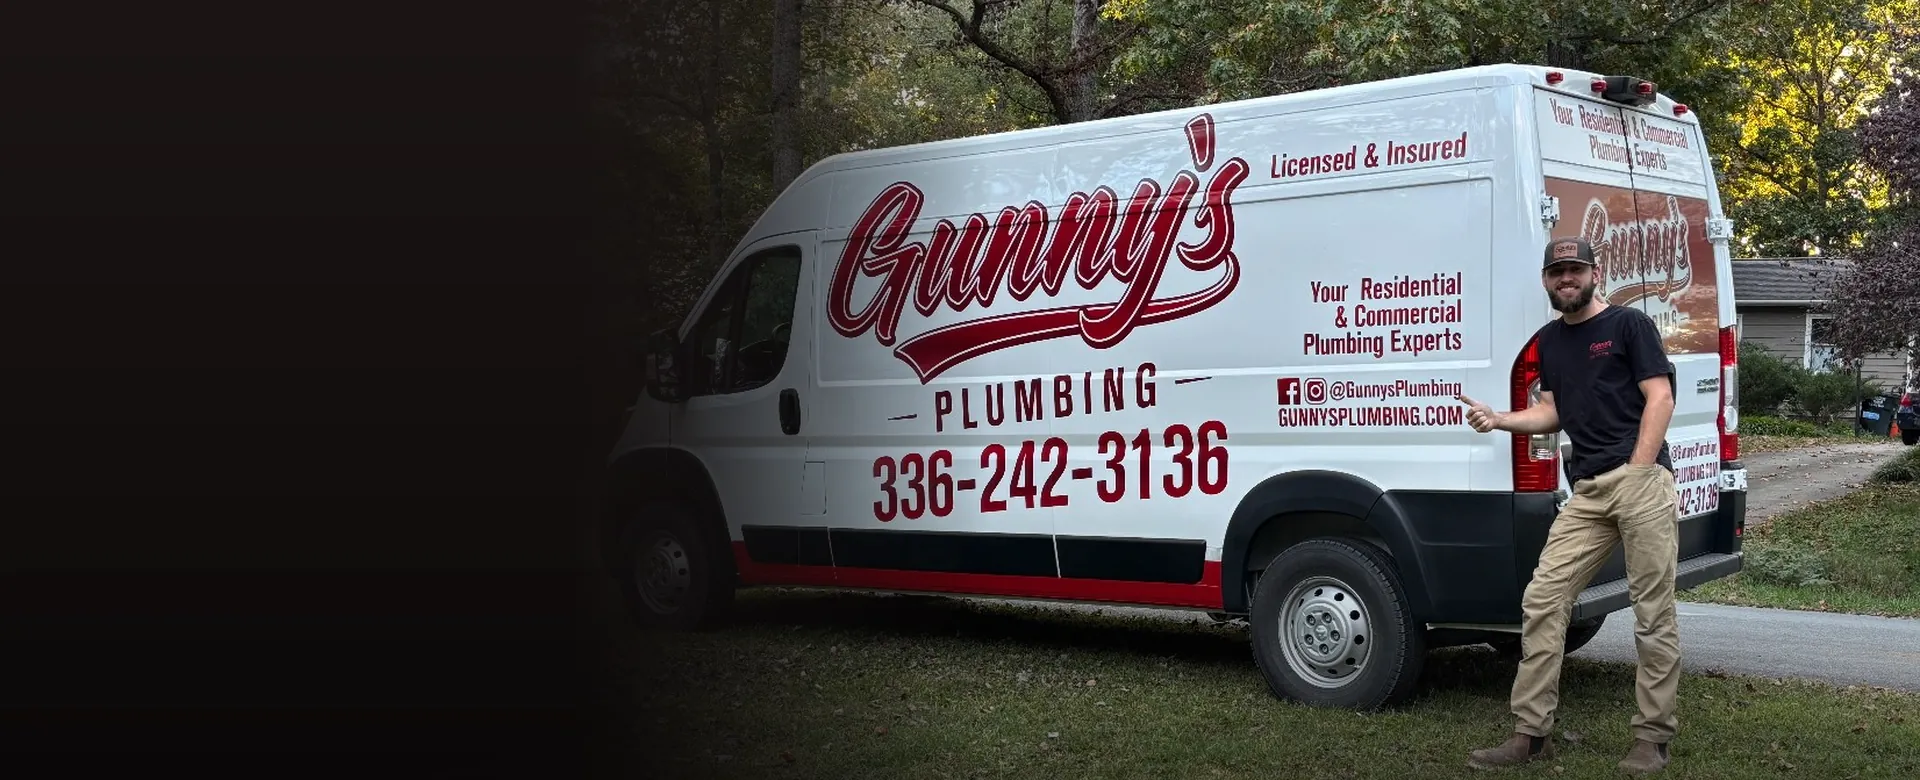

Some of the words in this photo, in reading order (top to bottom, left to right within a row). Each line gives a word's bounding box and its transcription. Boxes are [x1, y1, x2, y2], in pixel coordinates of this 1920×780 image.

[1549, 98, 1574, 126] Your
[1632, 116, 1641, 140] &
[1641, 118, 1689, 150] Commercial
[1270, 145, 1357, 179] Licensed
[1363, 142, 1379, 169] &
[1386, 131, 1468, 166] Insured
[1634, 143, 1668, 172] Experts
[827, 113, 1250, 349] Gunny's
[1582, 196, 1690, 302] Gunny's
[1310, 281, 1349, 303] Your
[1360, 271, 1462, 301] Residential
[1334, 305, 1348, 329] &
[1354, 298, 1462, 328] Commercial
[1303, 331, 1384, 359] Plumbing
[1390, 328, 1462, 357] Experts
[934, 362, 1157, 432] PLUMBING
[1329, 378, 1462, 401] @GunnysPlumbing
[1278, 405, 1463, 428] GUNNYSPLUMBING.COM
[873, 420, 1229, 522] 336-242-3136
[1674, 462, 1718, 484] PLUMBING.COM
[1677, 482, 1718, 516] 42-3136
